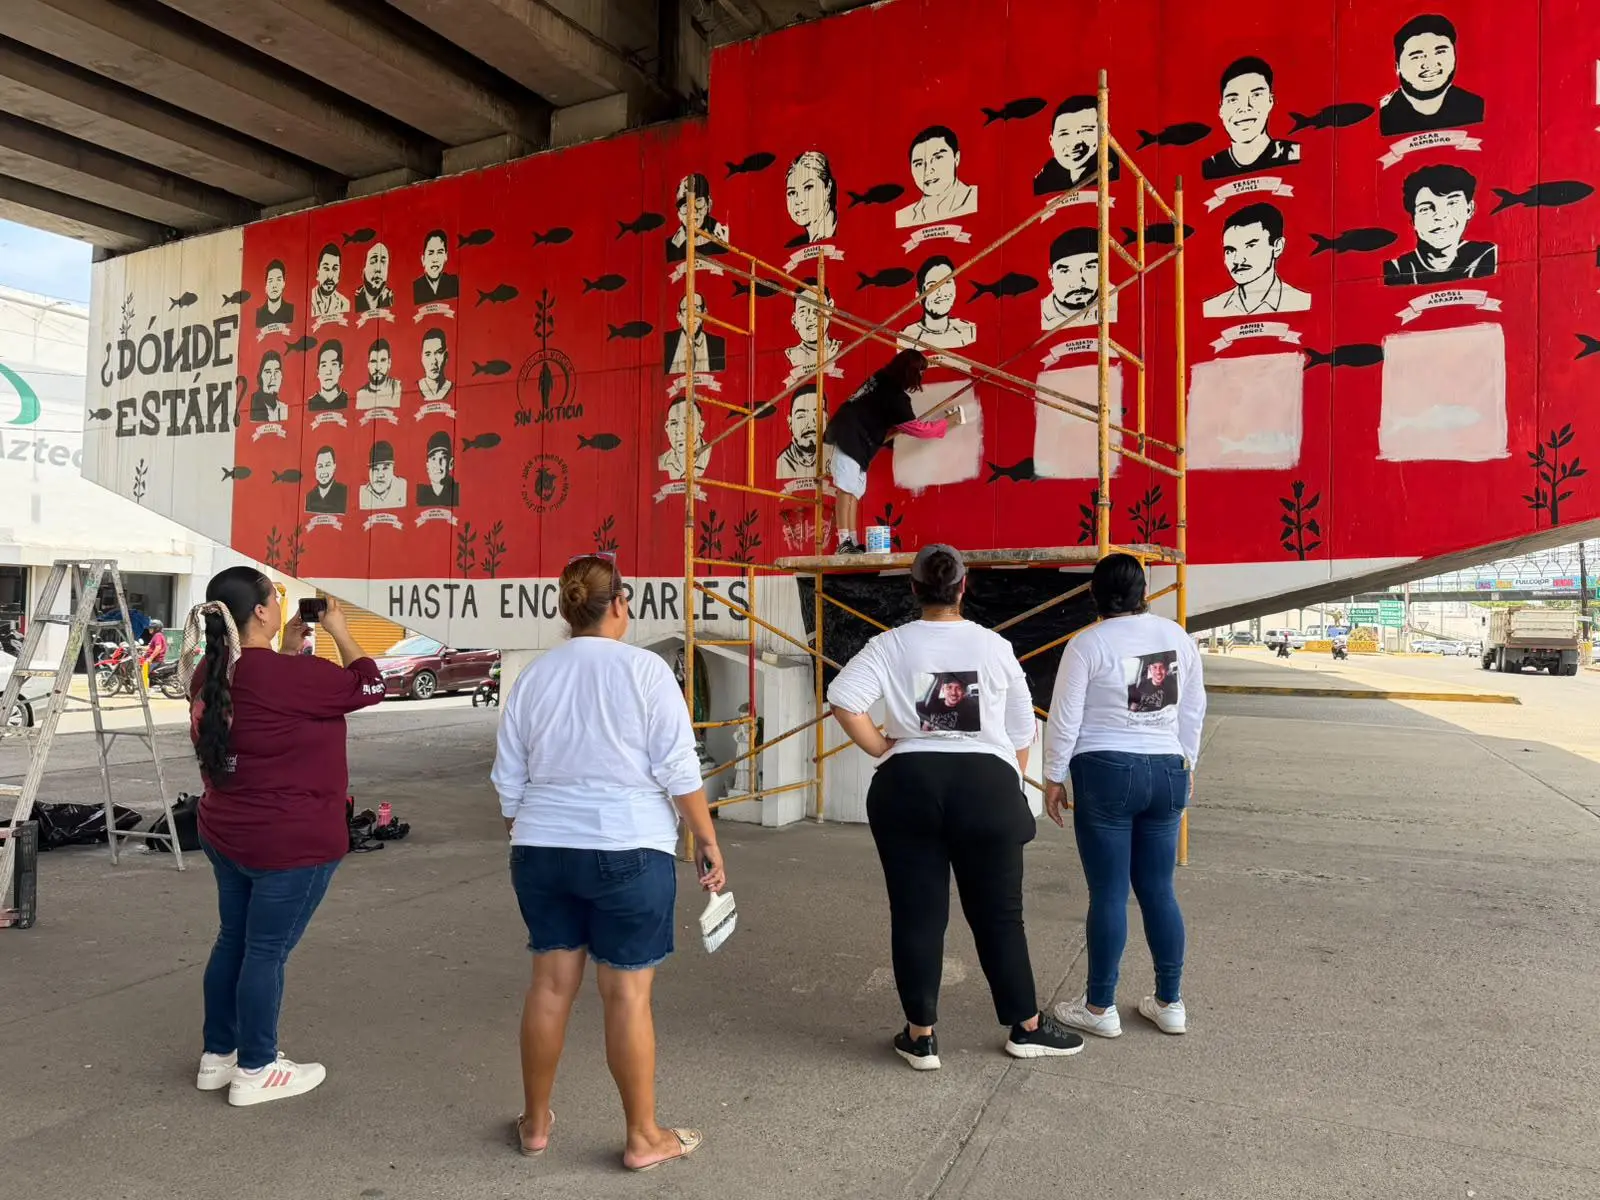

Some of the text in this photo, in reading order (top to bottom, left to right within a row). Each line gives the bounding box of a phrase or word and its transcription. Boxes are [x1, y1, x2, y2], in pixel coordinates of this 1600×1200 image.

[1413, 133, 1439, 142] OSCAR
[115, 372, 248, 437] ESTÁN?
[514, 403, 584, 426] SIN JUSTICIA
[389, 583, 478, 619] HASTA
